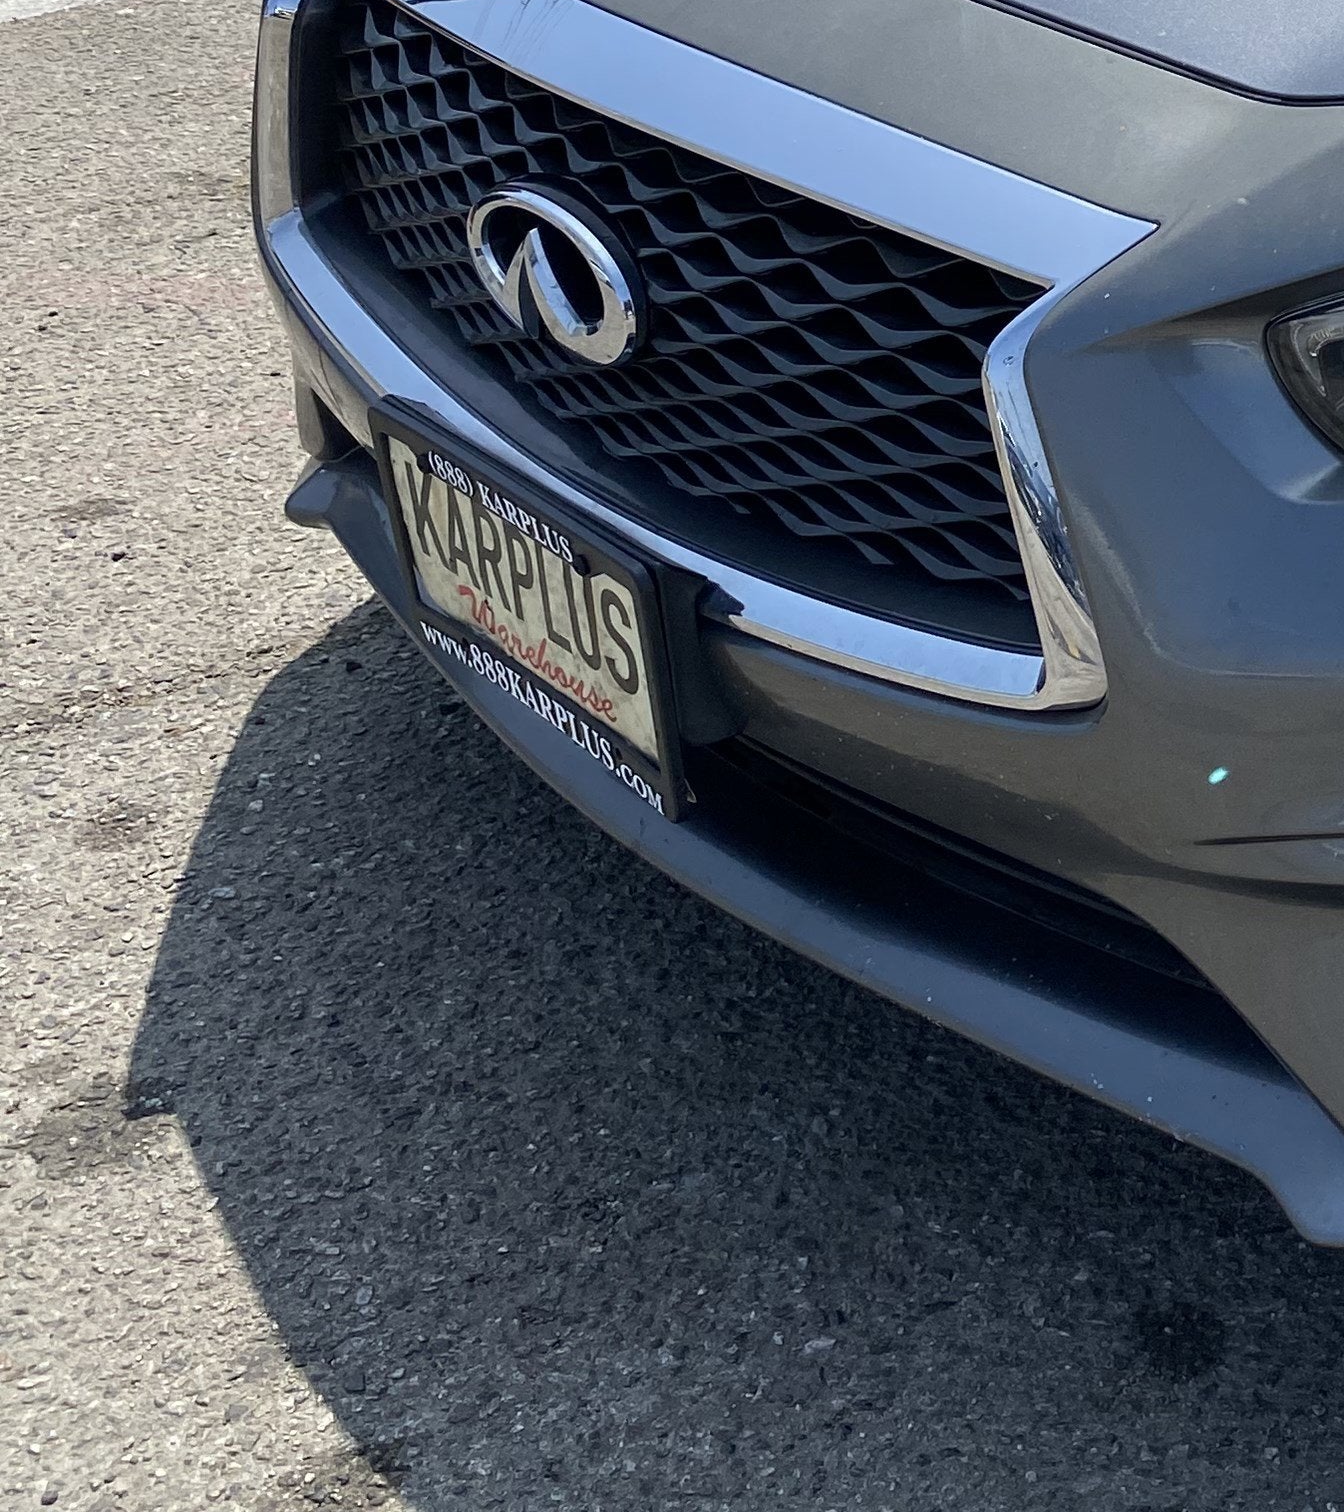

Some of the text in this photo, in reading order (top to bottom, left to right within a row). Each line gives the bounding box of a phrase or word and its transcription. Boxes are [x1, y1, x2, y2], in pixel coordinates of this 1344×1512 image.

[427, 450, 574, 564] (888) KARPLUS
[404, 461, 640, 696] KARPLUS
[456, 583, 618, 723] Warehouse
